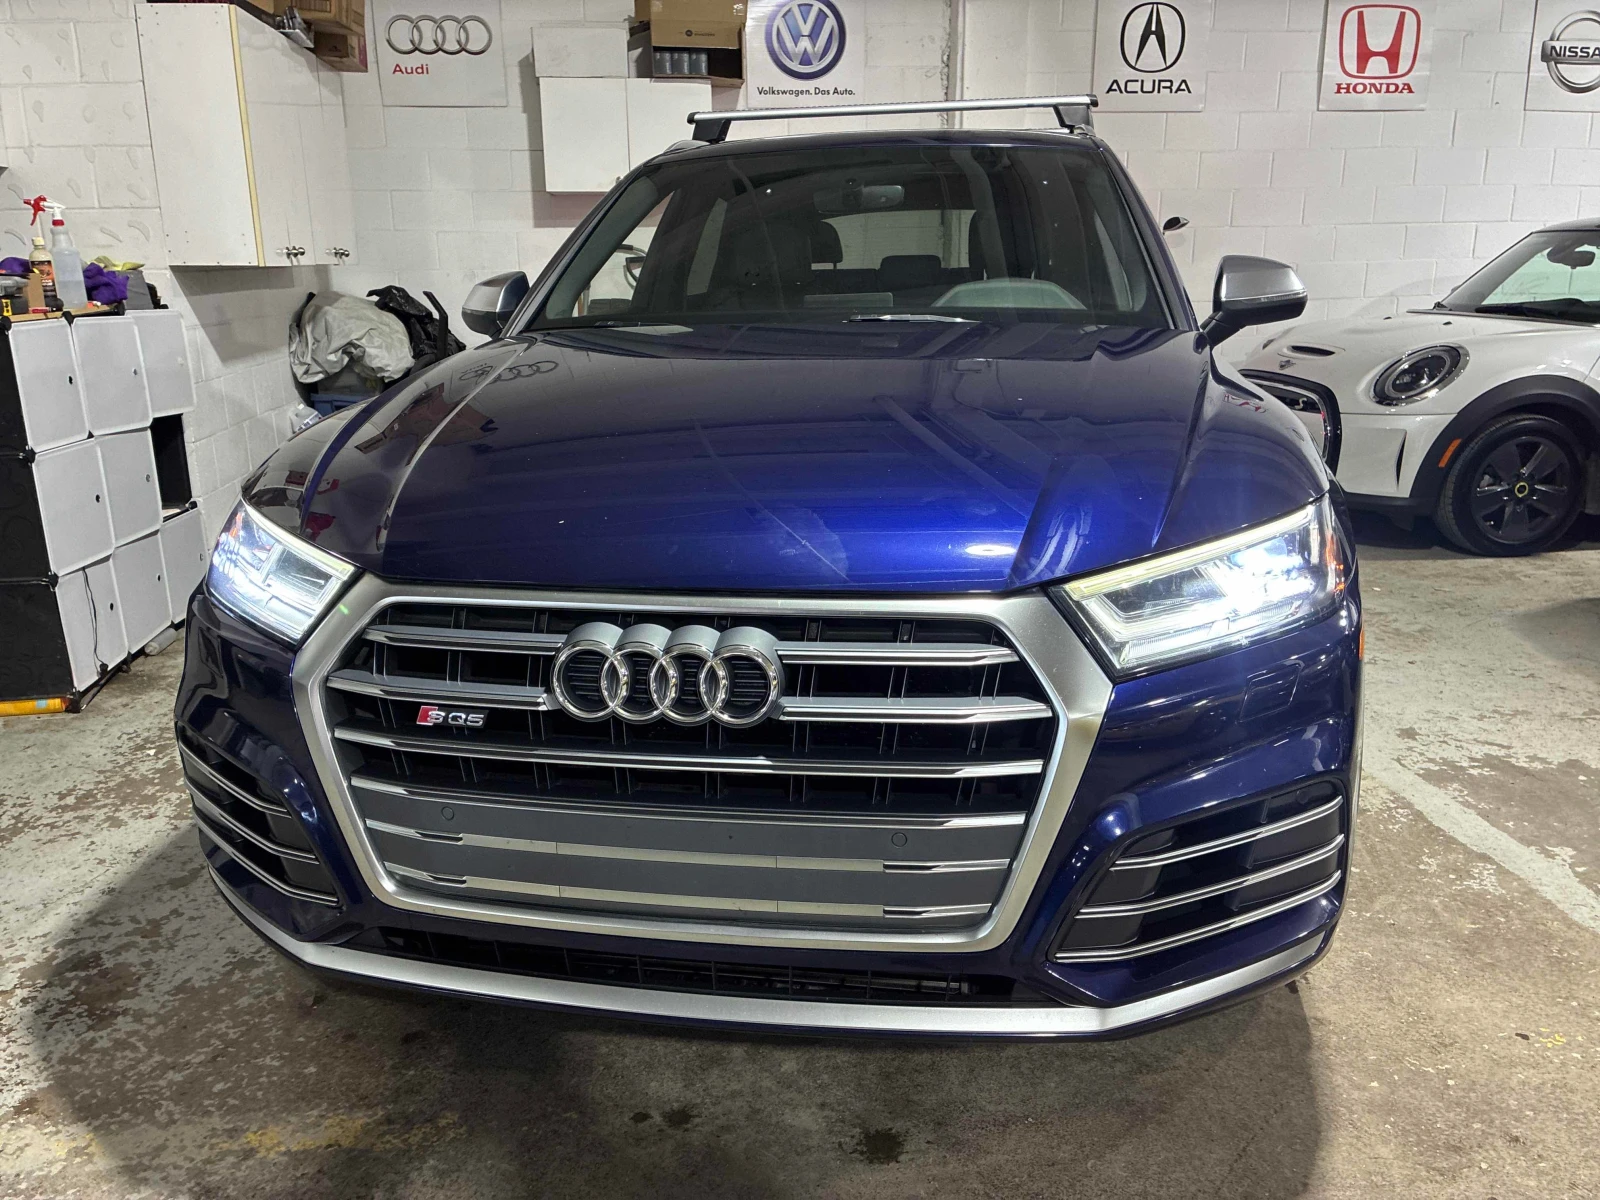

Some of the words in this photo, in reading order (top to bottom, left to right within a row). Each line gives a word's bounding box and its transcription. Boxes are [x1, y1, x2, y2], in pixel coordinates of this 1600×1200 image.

[392, 63, 429, 75] Audi
[756, 86, 812, 97] Volkswagen.
[814, 86, 830, 96] Das
[832, 86, 855, 96] Auto.
[1105, 79, 1192, 94] ACURA
[1334, 82, 1415, 94] HONDA
[426, 710, 485, 727] SQ5
